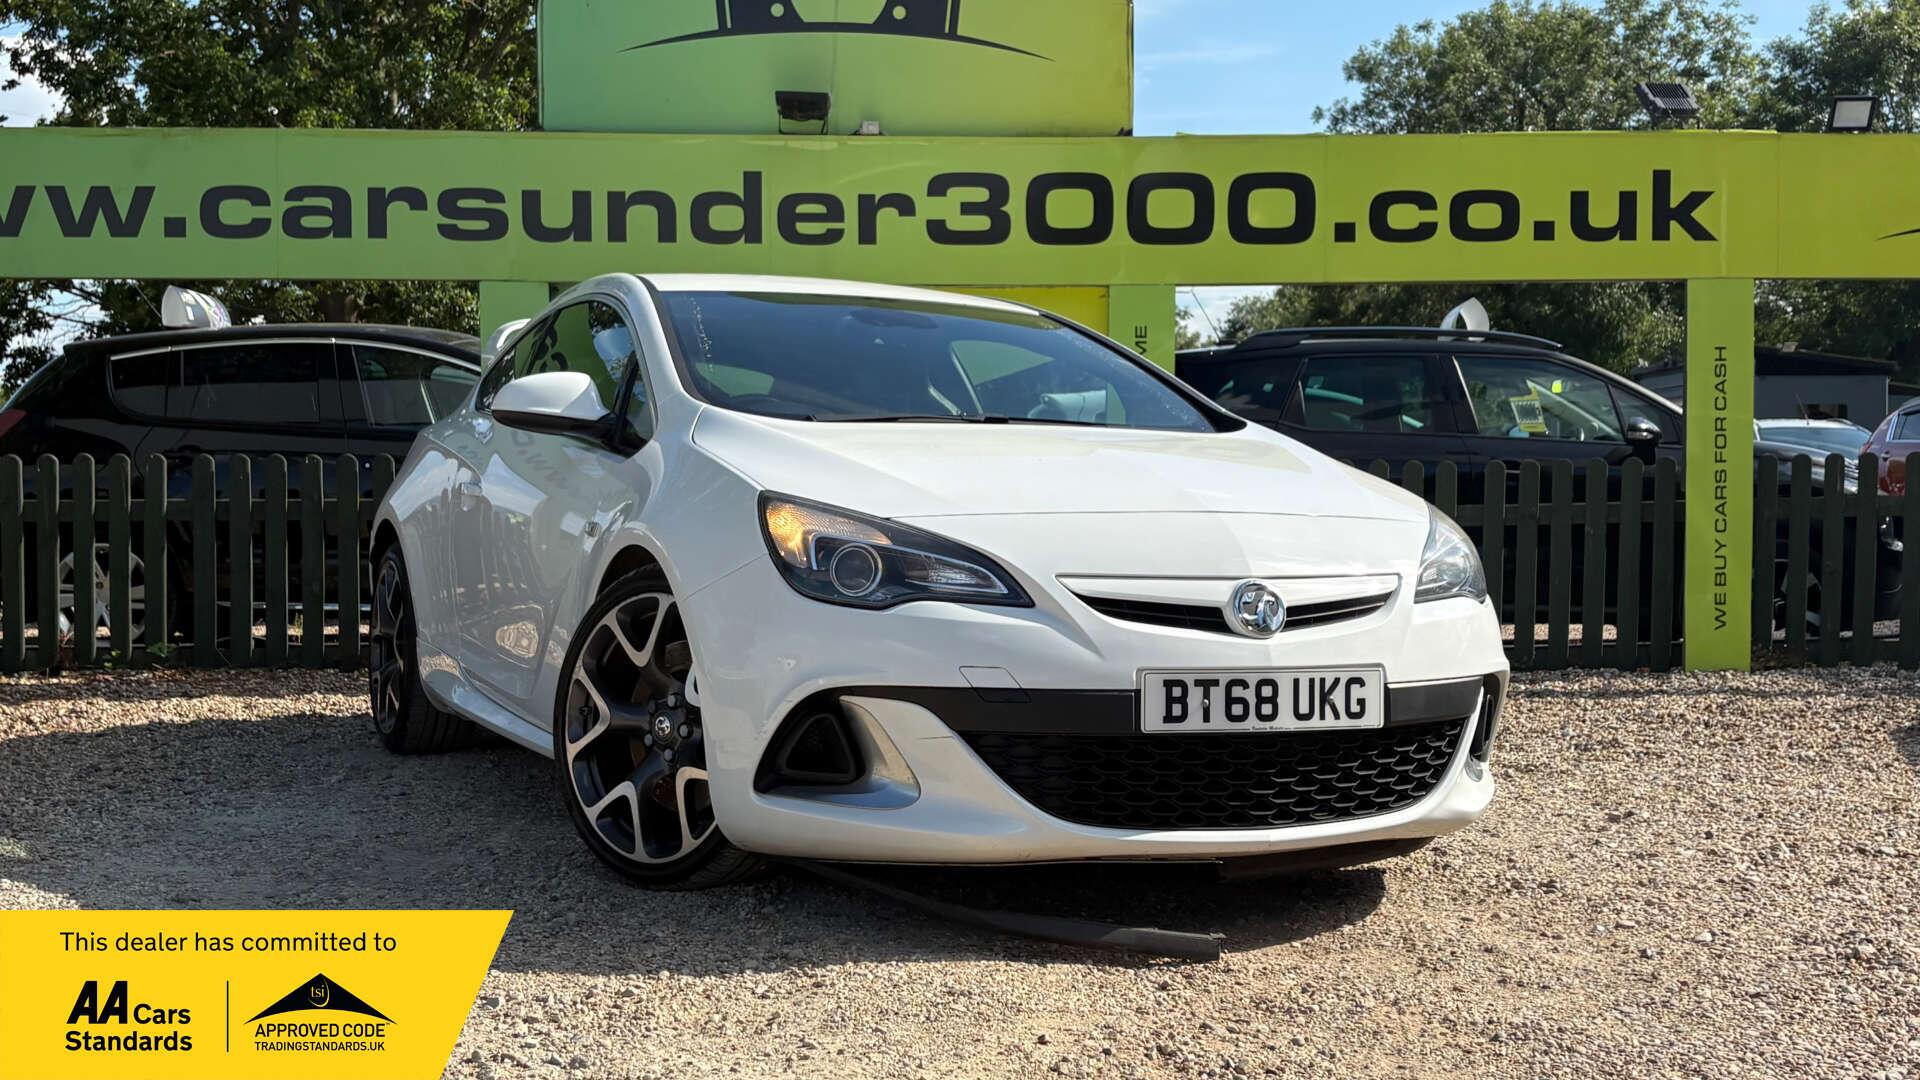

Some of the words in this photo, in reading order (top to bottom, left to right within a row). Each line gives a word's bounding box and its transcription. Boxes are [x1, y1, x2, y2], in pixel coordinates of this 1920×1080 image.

[1714, 346, 1727, 412] CASH
[1714, 416, 1727, 464] FOR
[1714, 469, 1727, 533] CARS
[1714, 539, 1727, 587] BUY
[1714, 592, 1727, 631] WE
[1162, 678, 1279, 724] BT68
[1292, 677, 1367, 722] UKG
